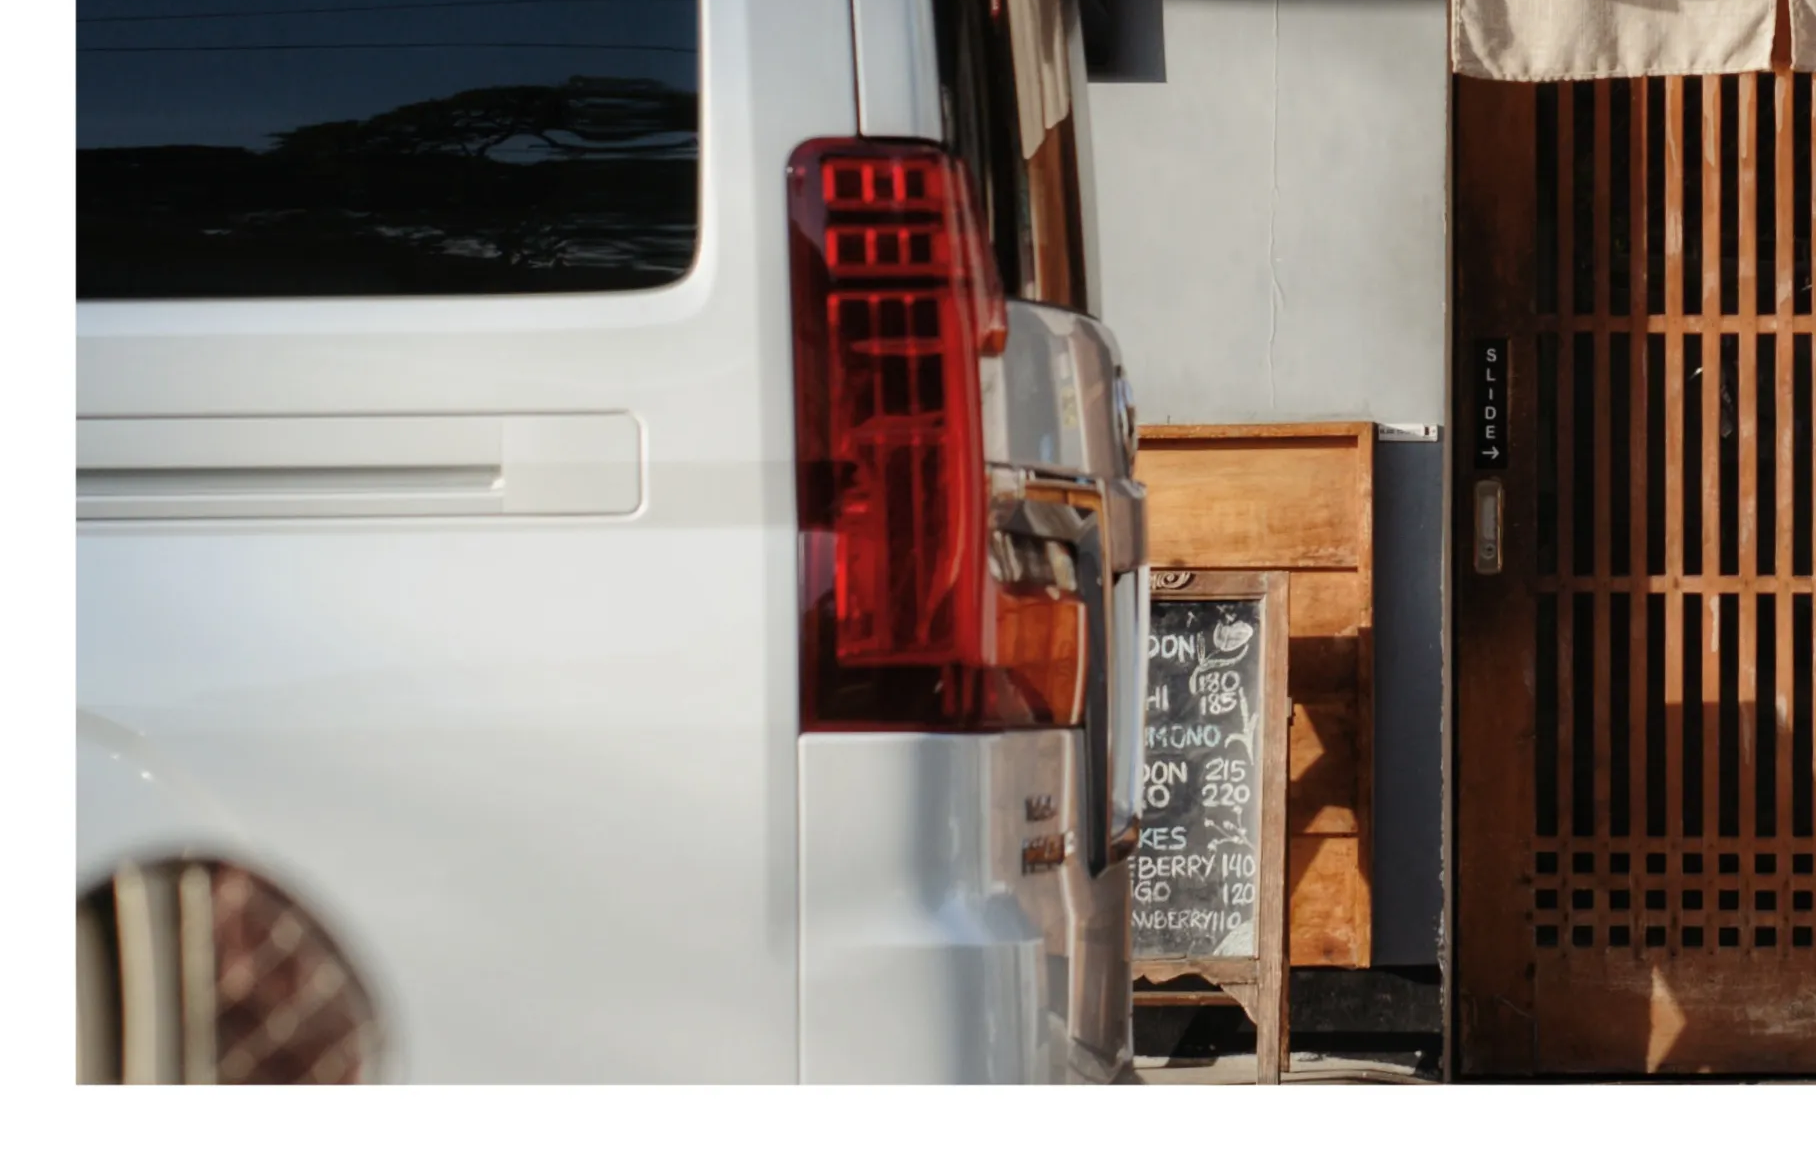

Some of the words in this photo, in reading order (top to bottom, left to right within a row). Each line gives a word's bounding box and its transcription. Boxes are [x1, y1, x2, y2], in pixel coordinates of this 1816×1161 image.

[1484, 348, 1497, 440] SLIDE
[1200, 670, 1241, 692] 180
[1201, 692, 1237, 715] 185
[1145, 724, 1221, 749] MONO
[1205, 758, 1247, 782] 215
[1201, 784, 1250, 807] 220
[1222, 853, 1256, 878] 140
[1223, 882, 1256, 905] 120
